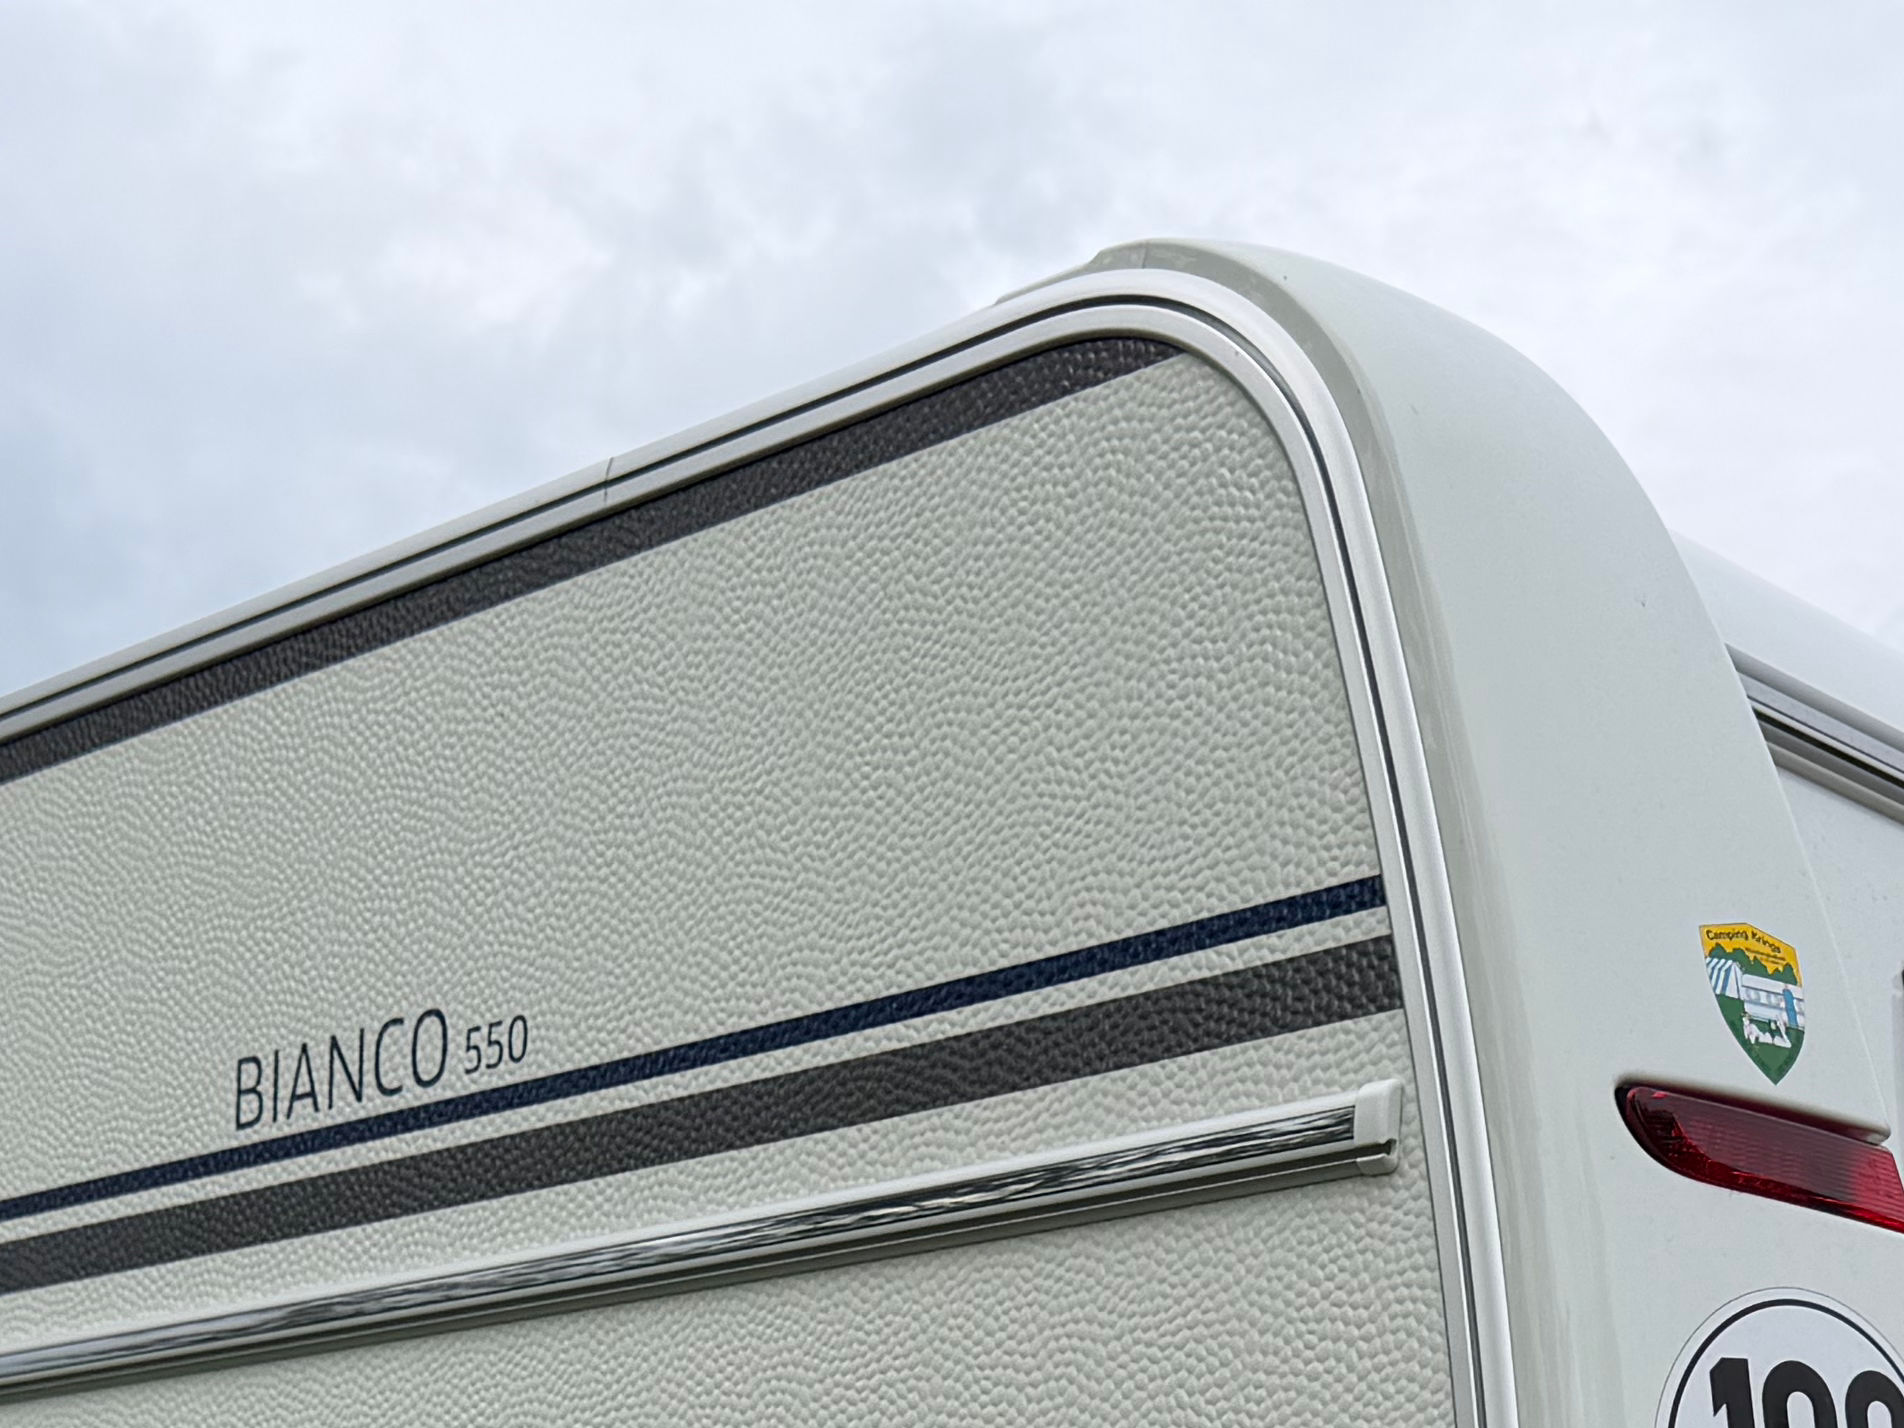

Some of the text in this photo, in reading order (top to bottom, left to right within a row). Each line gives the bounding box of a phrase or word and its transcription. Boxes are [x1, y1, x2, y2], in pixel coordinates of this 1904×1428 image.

[1705, 929, 1748, 941] Camping
[234, 1008, 529, 1131] BIANCO 550
